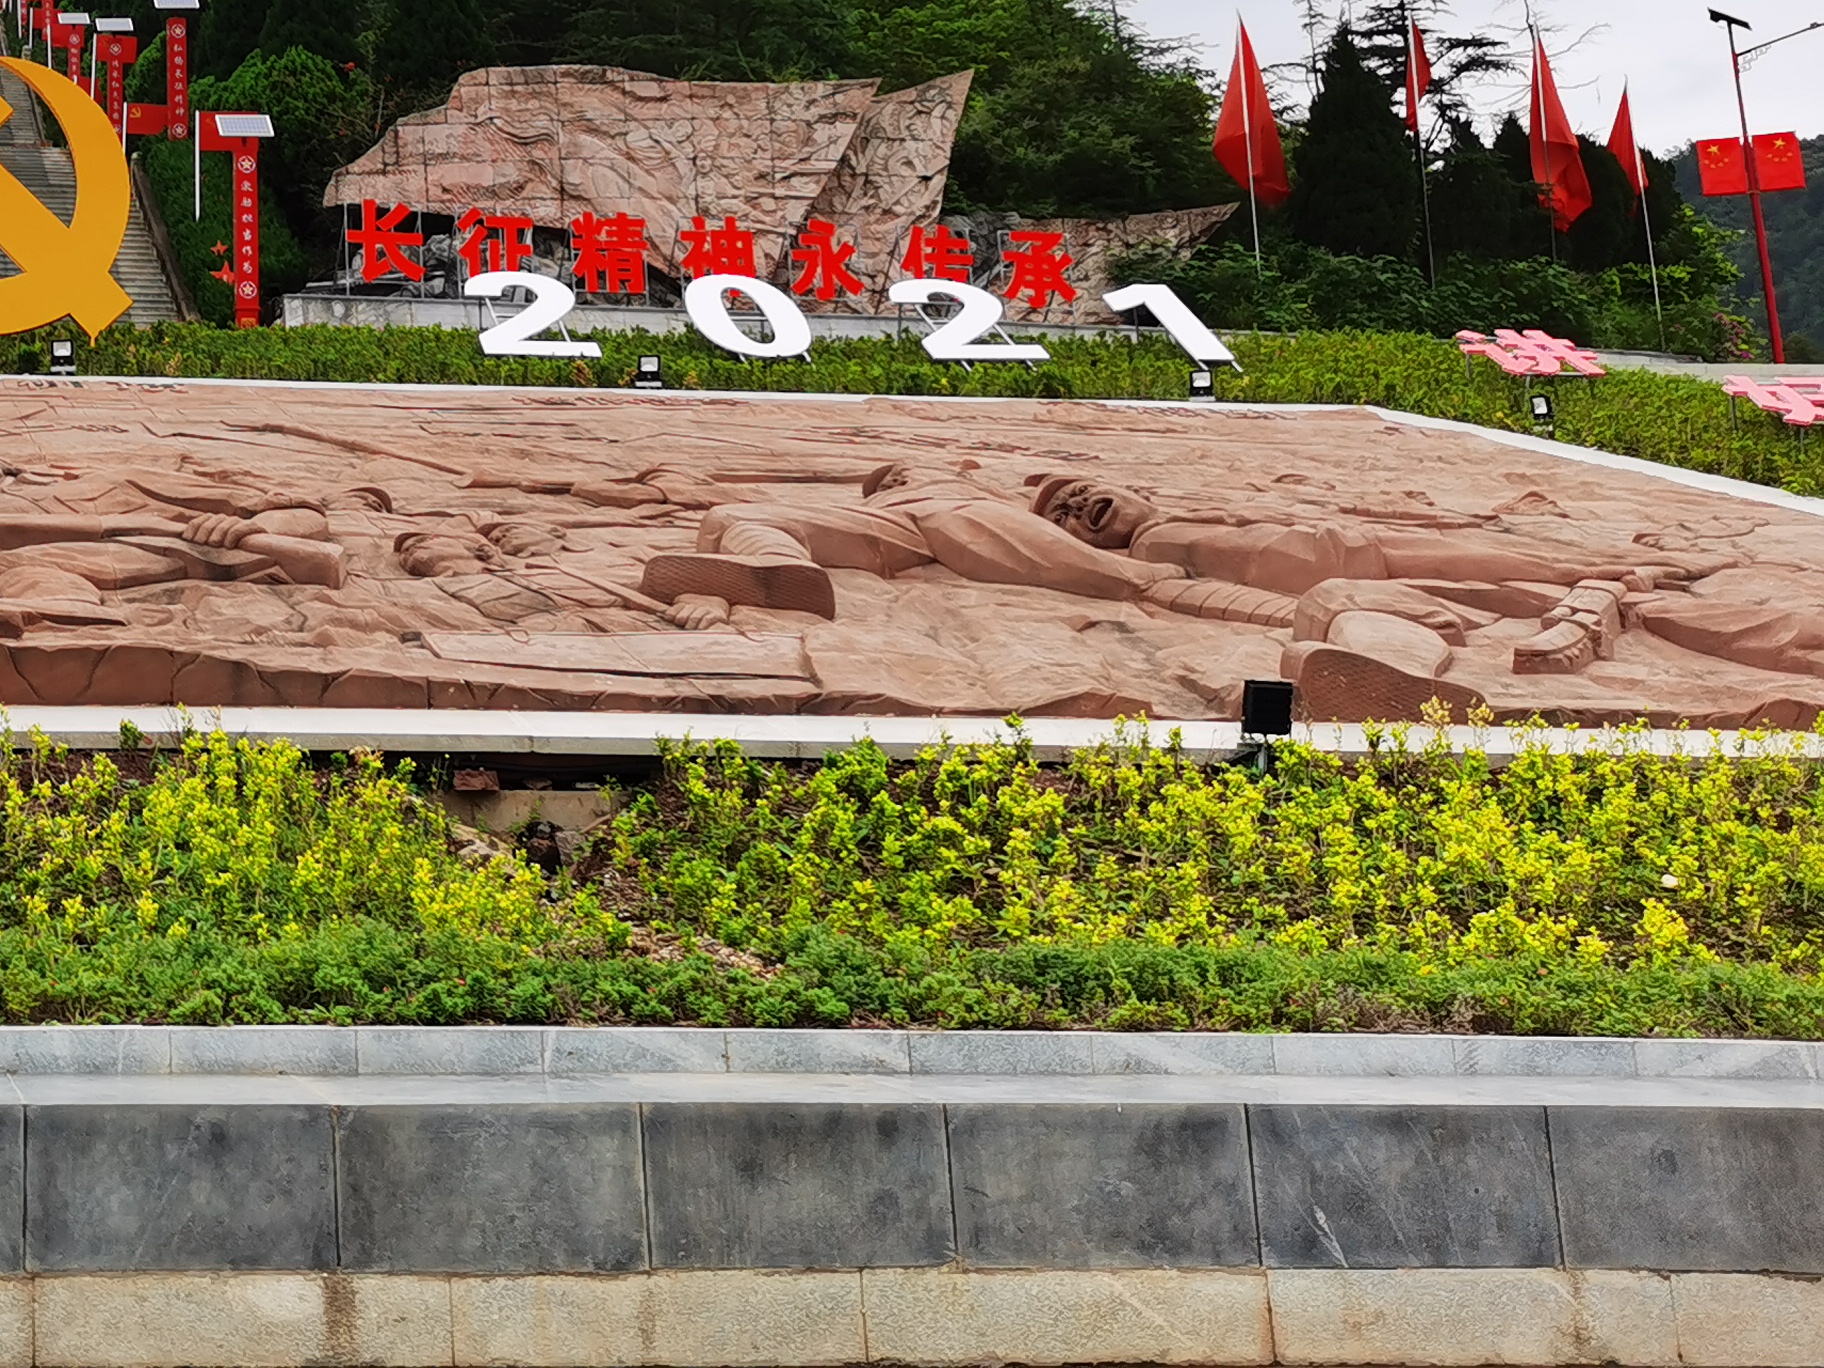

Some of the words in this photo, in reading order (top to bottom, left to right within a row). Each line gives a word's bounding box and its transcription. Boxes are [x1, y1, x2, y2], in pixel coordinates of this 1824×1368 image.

[173, 43, 186, 117] 弘扬长征精神
[346, 199, 1077, 308] 长征精神永传承
[464, 271, 1233, 364] 2021
